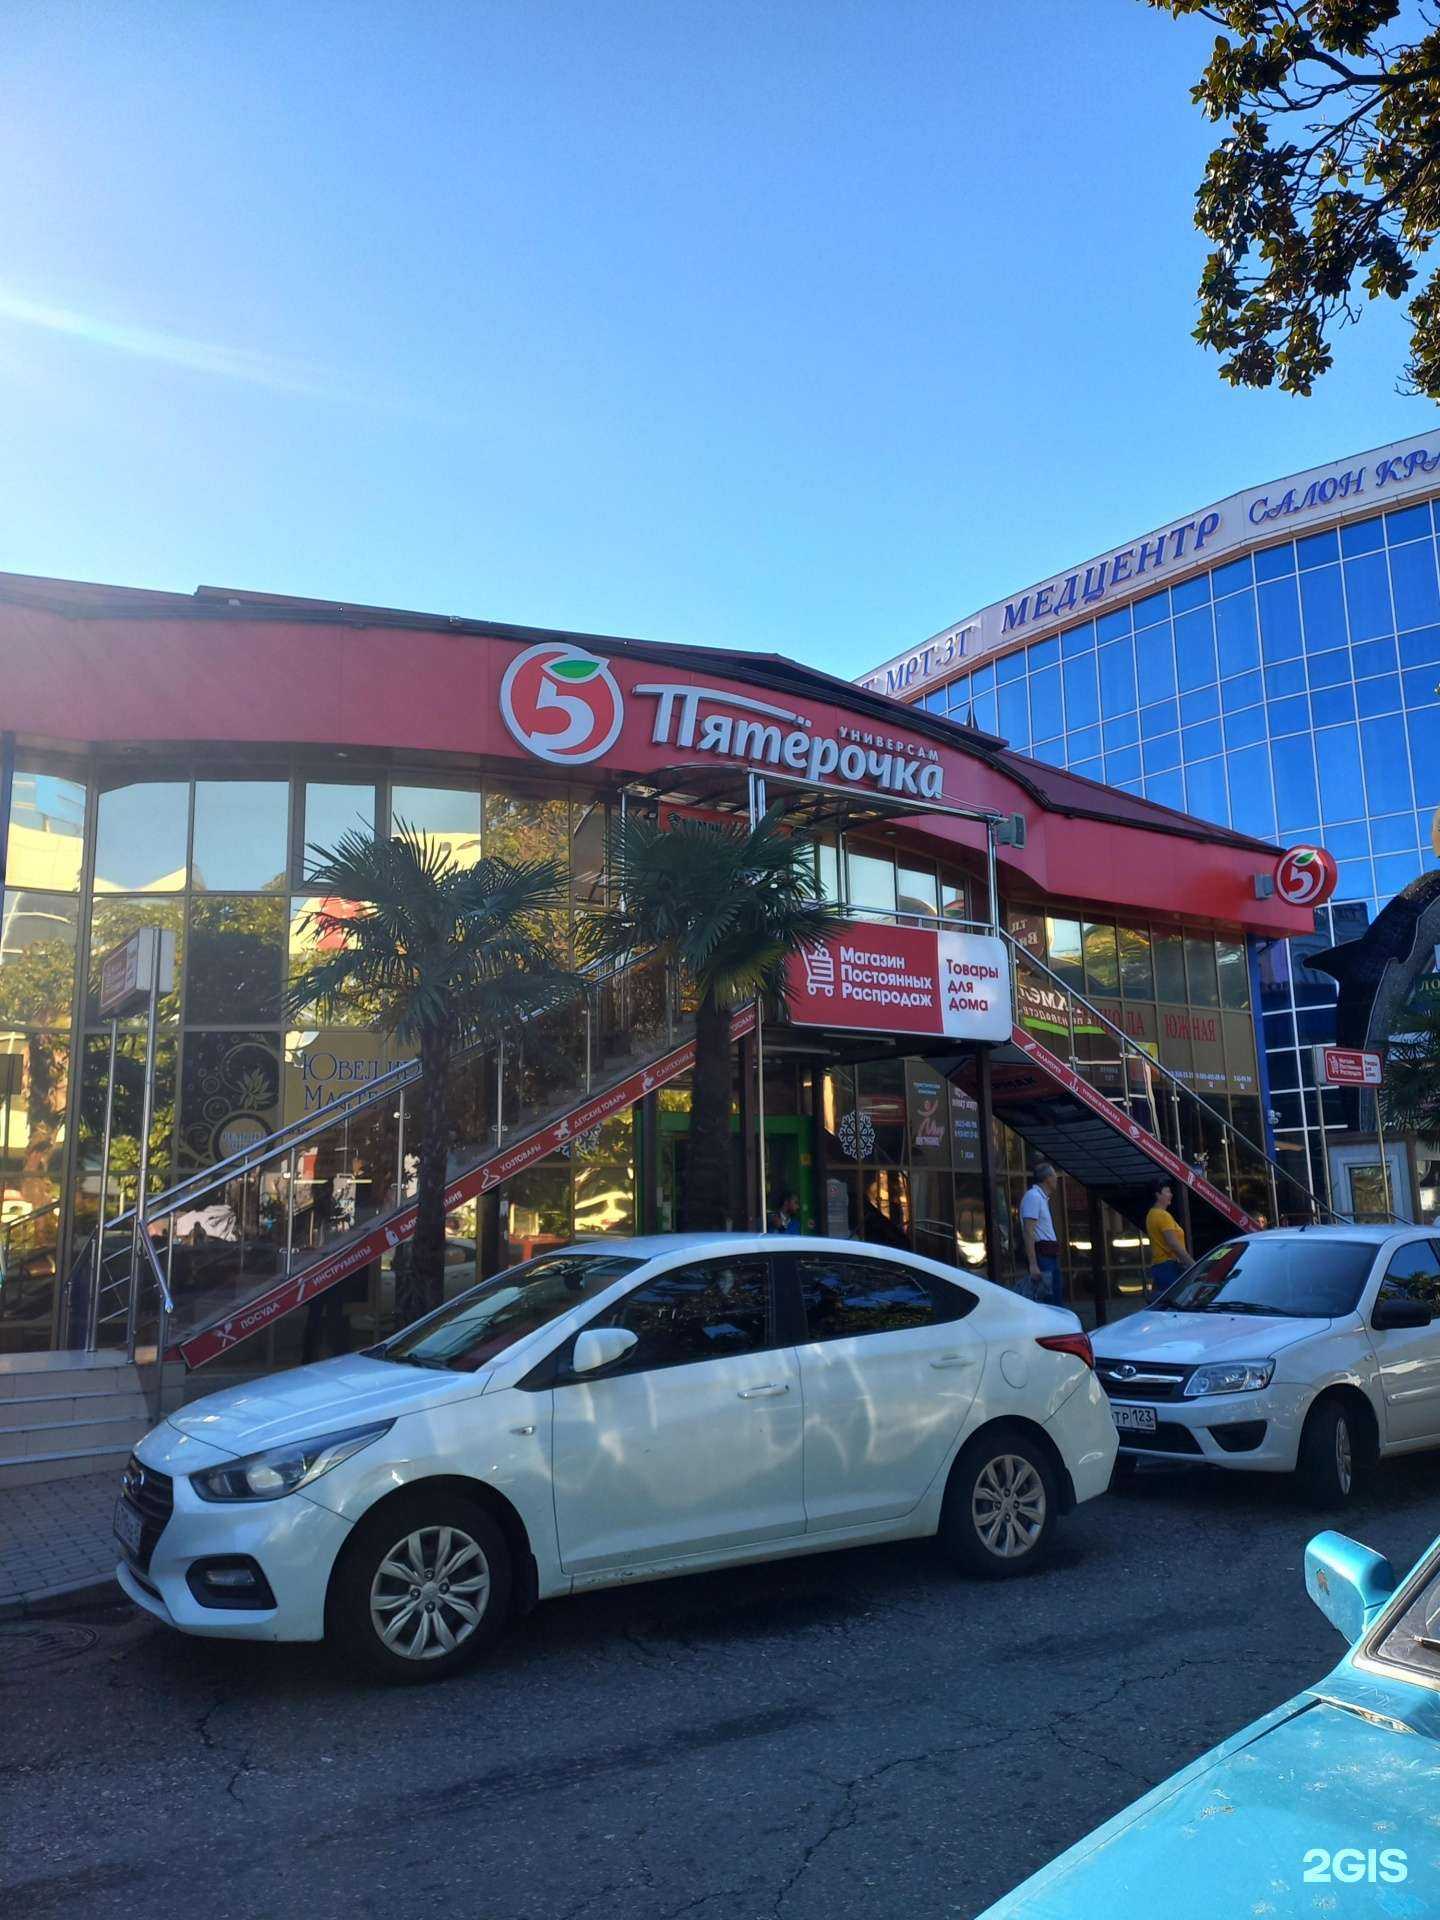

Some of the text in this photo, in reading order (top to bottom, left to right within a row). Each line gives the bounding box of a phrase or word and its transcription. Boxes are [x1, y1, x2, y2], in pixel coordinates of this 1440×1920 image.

[1249, 466, 1367, 526] САЛОН
[1001, 512, 1220, 635] МЕДЦЕНТР
[632, 683, 944, 800] Пятёрочка
[839, 725, 940, 762] УНИВЕРСАМ
[839, 945, 906, 969] Магазин
[946, 958, 1000, 980] Товары
[840, 964, 933, 990] Постоянных
[841, 984, 933, 1007] Распродаж
[949, 996, 989, 1012] дома
[500, 1143, 543, 1173] ХОЗТОВАРЫ
[311, 1245, 373, 1288] ИНСТРУМЕНТЫ
[239, 1300, 281, 1330] ПОСУДА
[1132, 1408, 1153, 1424] 123
